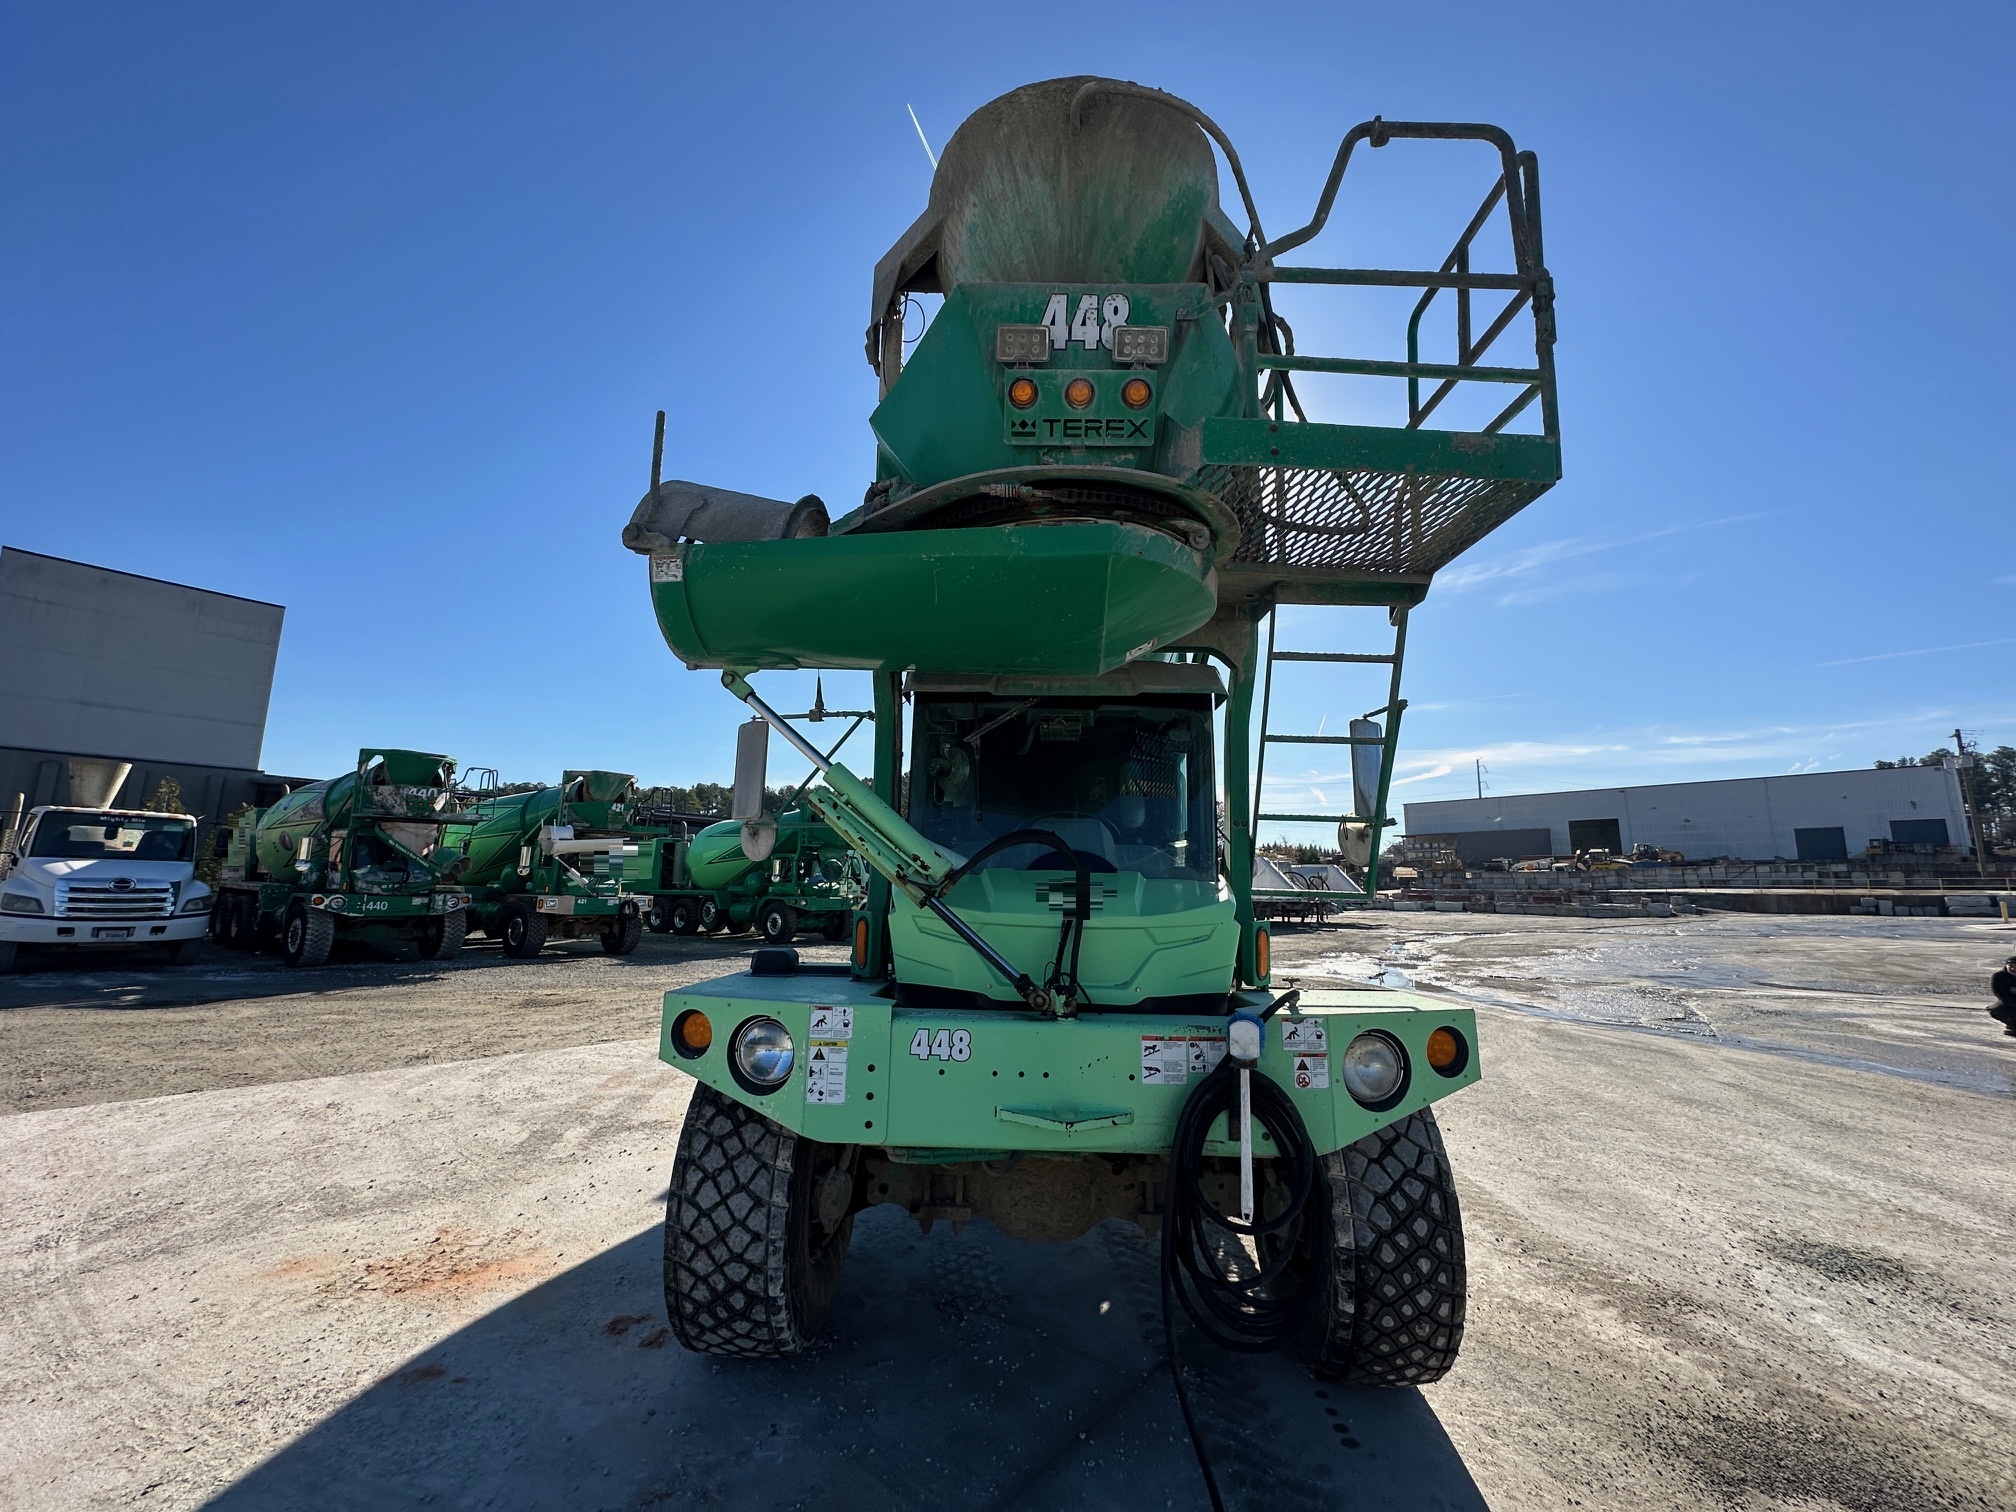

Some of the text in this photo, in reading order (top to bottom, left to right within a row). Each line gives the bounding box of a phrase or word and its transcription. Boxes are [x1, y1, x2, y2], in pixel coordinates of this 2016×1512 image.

[1040, 292, 1131, 351] 448
[1042, 418, 1149, 439] TEREX
[366, 901, 389, 911] 440
[909, 1027, 972, 1063] 448
